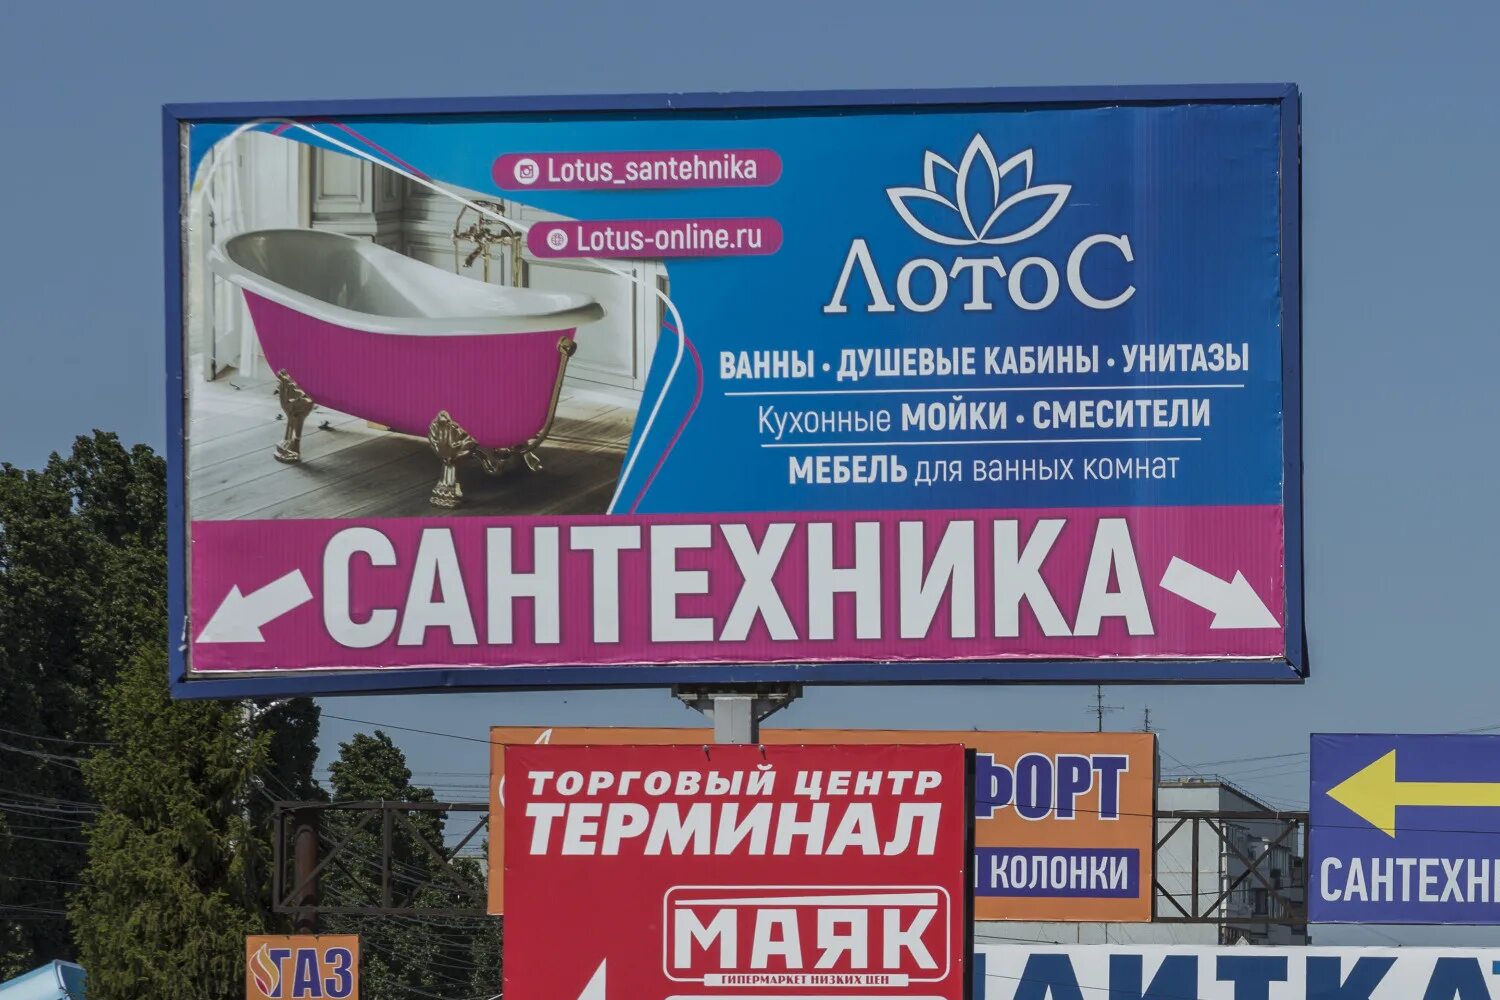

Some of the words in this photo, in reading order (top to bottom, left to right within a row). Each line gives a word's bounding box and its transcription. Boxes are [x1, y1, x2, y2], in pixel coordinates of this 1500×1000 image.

[548, 153, 757, 186] Lotus_santehnika
[577, 223, 762, 254] Lotus-online.ru
[719, 349, 815, 381] ВАННЫ
[837, 346, 976, 382] ДУШЕВЫЕ
[984, 344, 1100, 376] КАБИНЫ
[1122, 342, 1250, 374] УНИТАЗЫ
[757, 403, 891, 438] Кухонные
[901, 398, 1008, 432] МОЙКИ
[1032, 396, 1212, 430] СМЕСИТЕЛИ
[789, 456, 908, 486] МЕБЕЛЬ
[915, 459, 962, 487] для
[971, 457, 1074, 482] ванных
[1083, 454, 1180, 480] комнат
[321, 516, 1157, 649] САНТЕХНИКА
[527, 764, 777, 796] ТОРГОВЫЙ
[793, 770, 943, 801] ЦЕНТР
[525, 802, 942, 856] ТЕРМИНАЛ
[991, 854, 1129, 890] КОЛОНКИ
[674, 907, 941, 970] МАЯК
[272, 948, 354, 1000] ГАЗ
[721, 974, 807, 986] ГИПЕРМАРКЕТ
[809, 974, 862, 986] НИЗКИХ
[864, 974, 892, 987] ЦЕН
